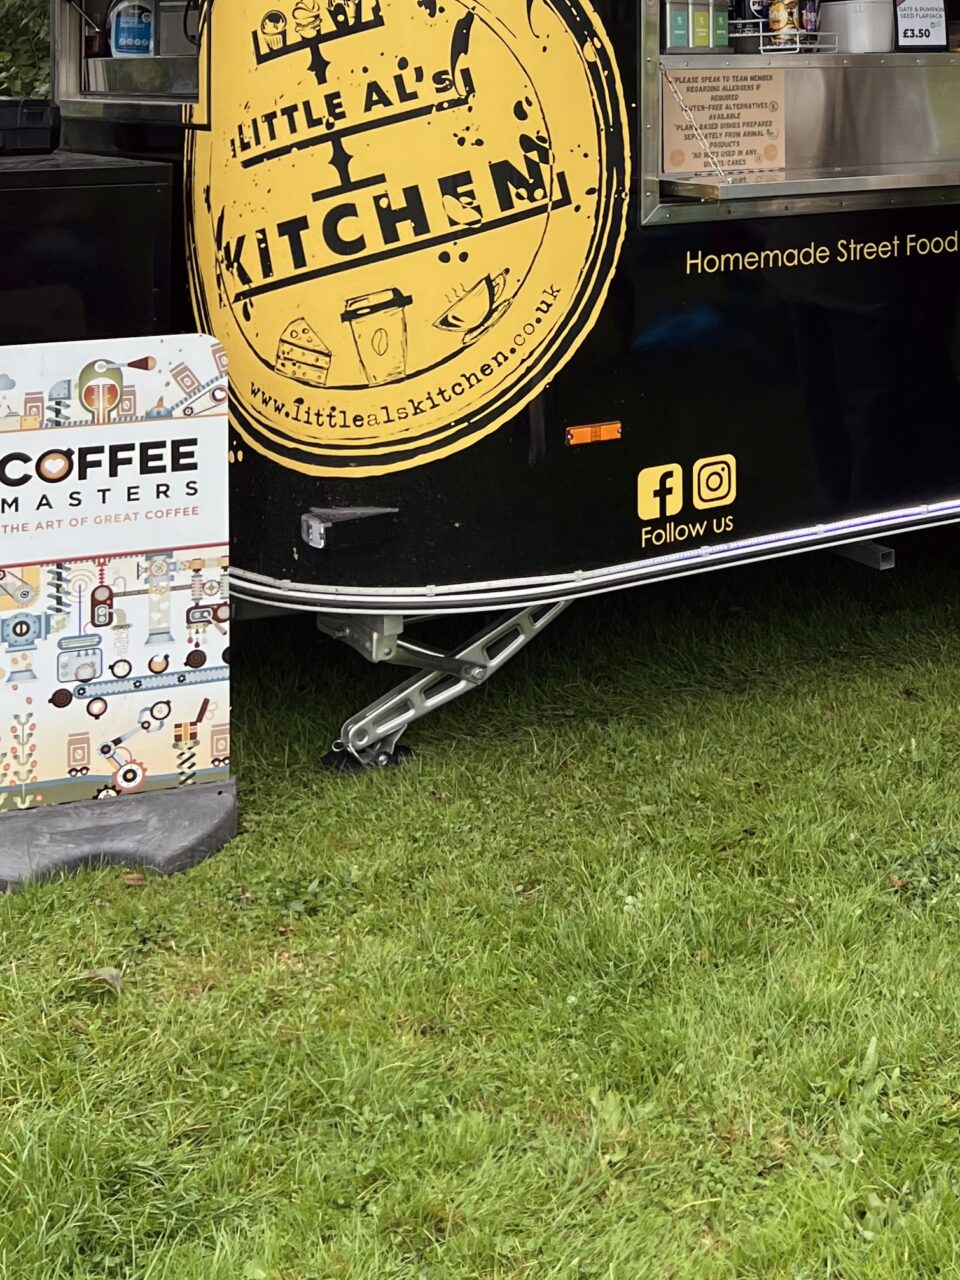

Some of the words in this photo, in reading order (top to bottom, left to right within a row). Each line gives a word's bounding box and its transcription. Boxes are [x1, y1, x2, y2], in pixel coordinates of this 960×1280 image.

[903, 28, 930, 38] £3.50
[237, 91, 347, 152] LITTLE
[725, 102, 768, 110] ALTERNATIVES
[223, 158, 549, 286] KITCHEN
[686, 242, 830, 274] Homemade
[837, 235, 900, 262] Street
[906, 230, 958, 256] Food
[250, 283, 562, 428] www.littlealskitchen.co.uk
[0, 437, 198, 487] COFFEE
[1, 481, 198, 514] MASTERS
[1, 522, 29, 534] THE
[35, 519, 63, 531] ART
[68, 517, 88, 528] OF
[94, 511, 140, 525] GREAT
[145, 506, 199, 520] COFFEE
[641, 520, 707, 548] Follow
